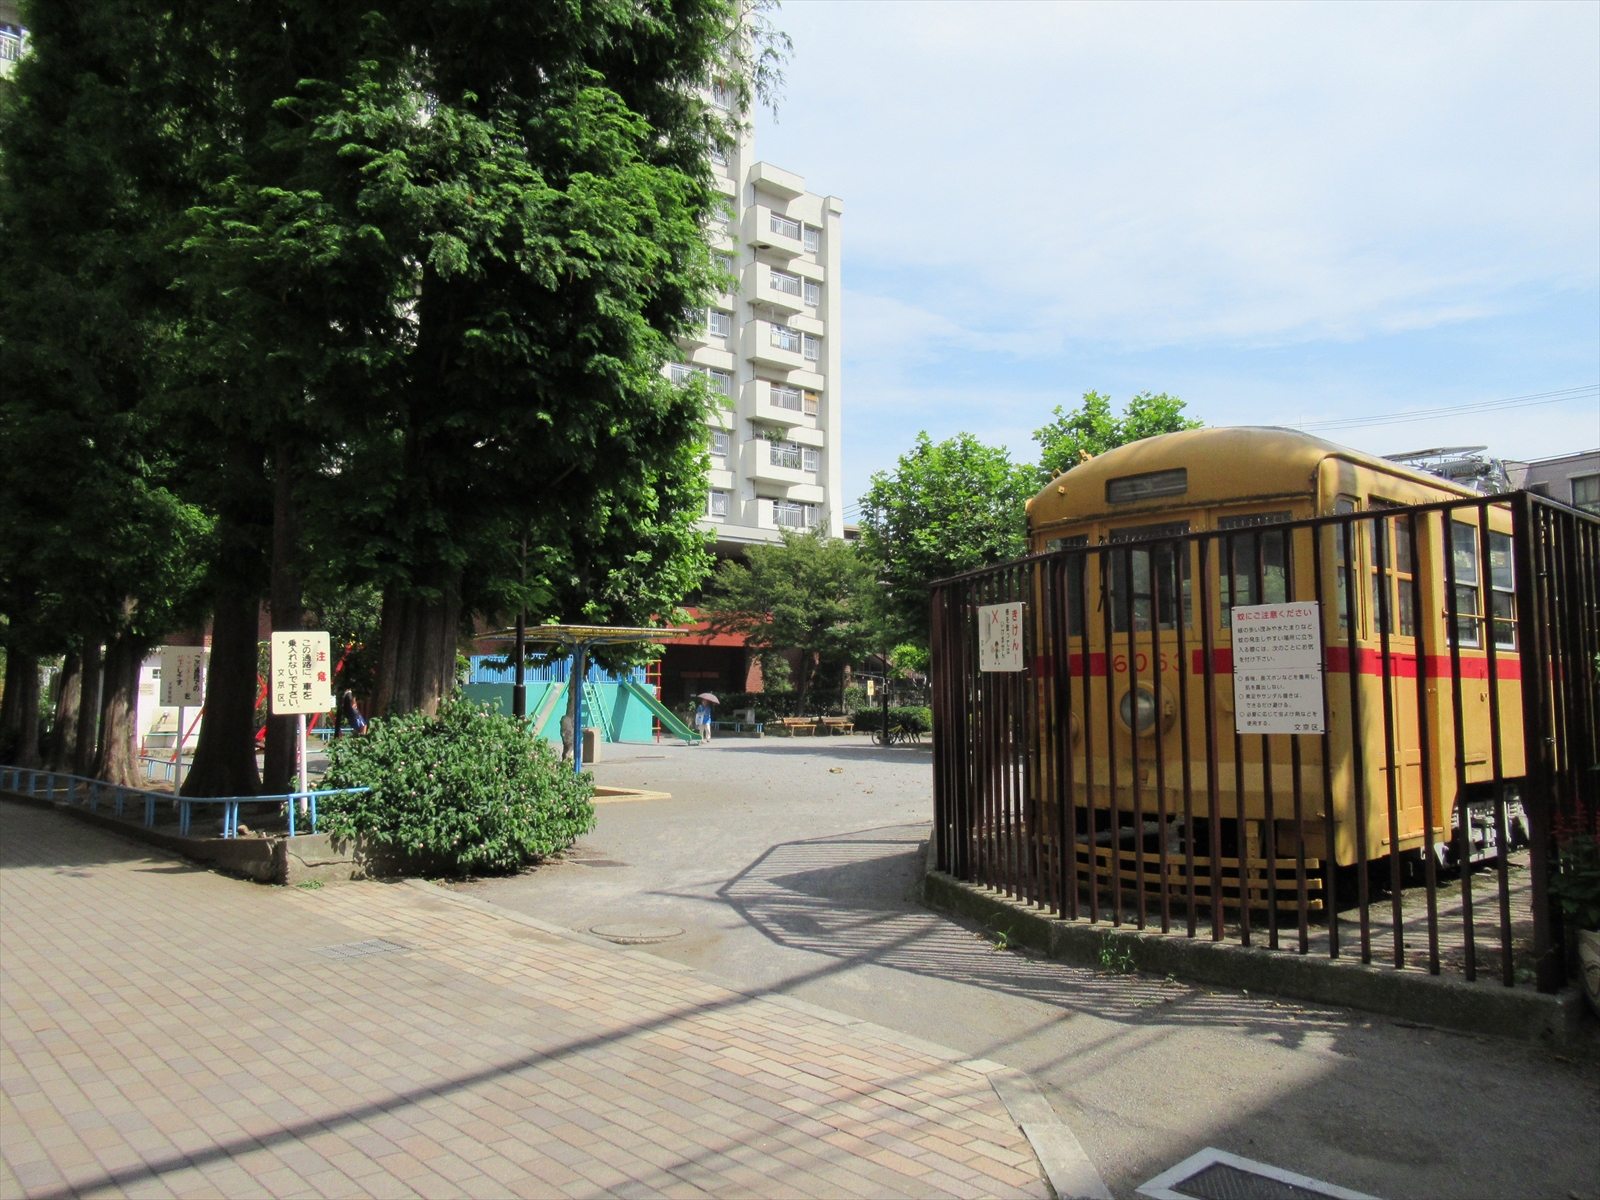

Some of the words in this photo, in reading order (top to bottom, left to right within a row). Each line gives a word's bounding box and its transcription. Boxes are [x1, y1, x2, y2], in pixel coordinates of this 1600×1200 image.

[1237, 610, 1312, 621] 蚊にご注意ください
[277, 668, 285, 702] 文京区
[1294, 723, 1318, 731] 文京区
